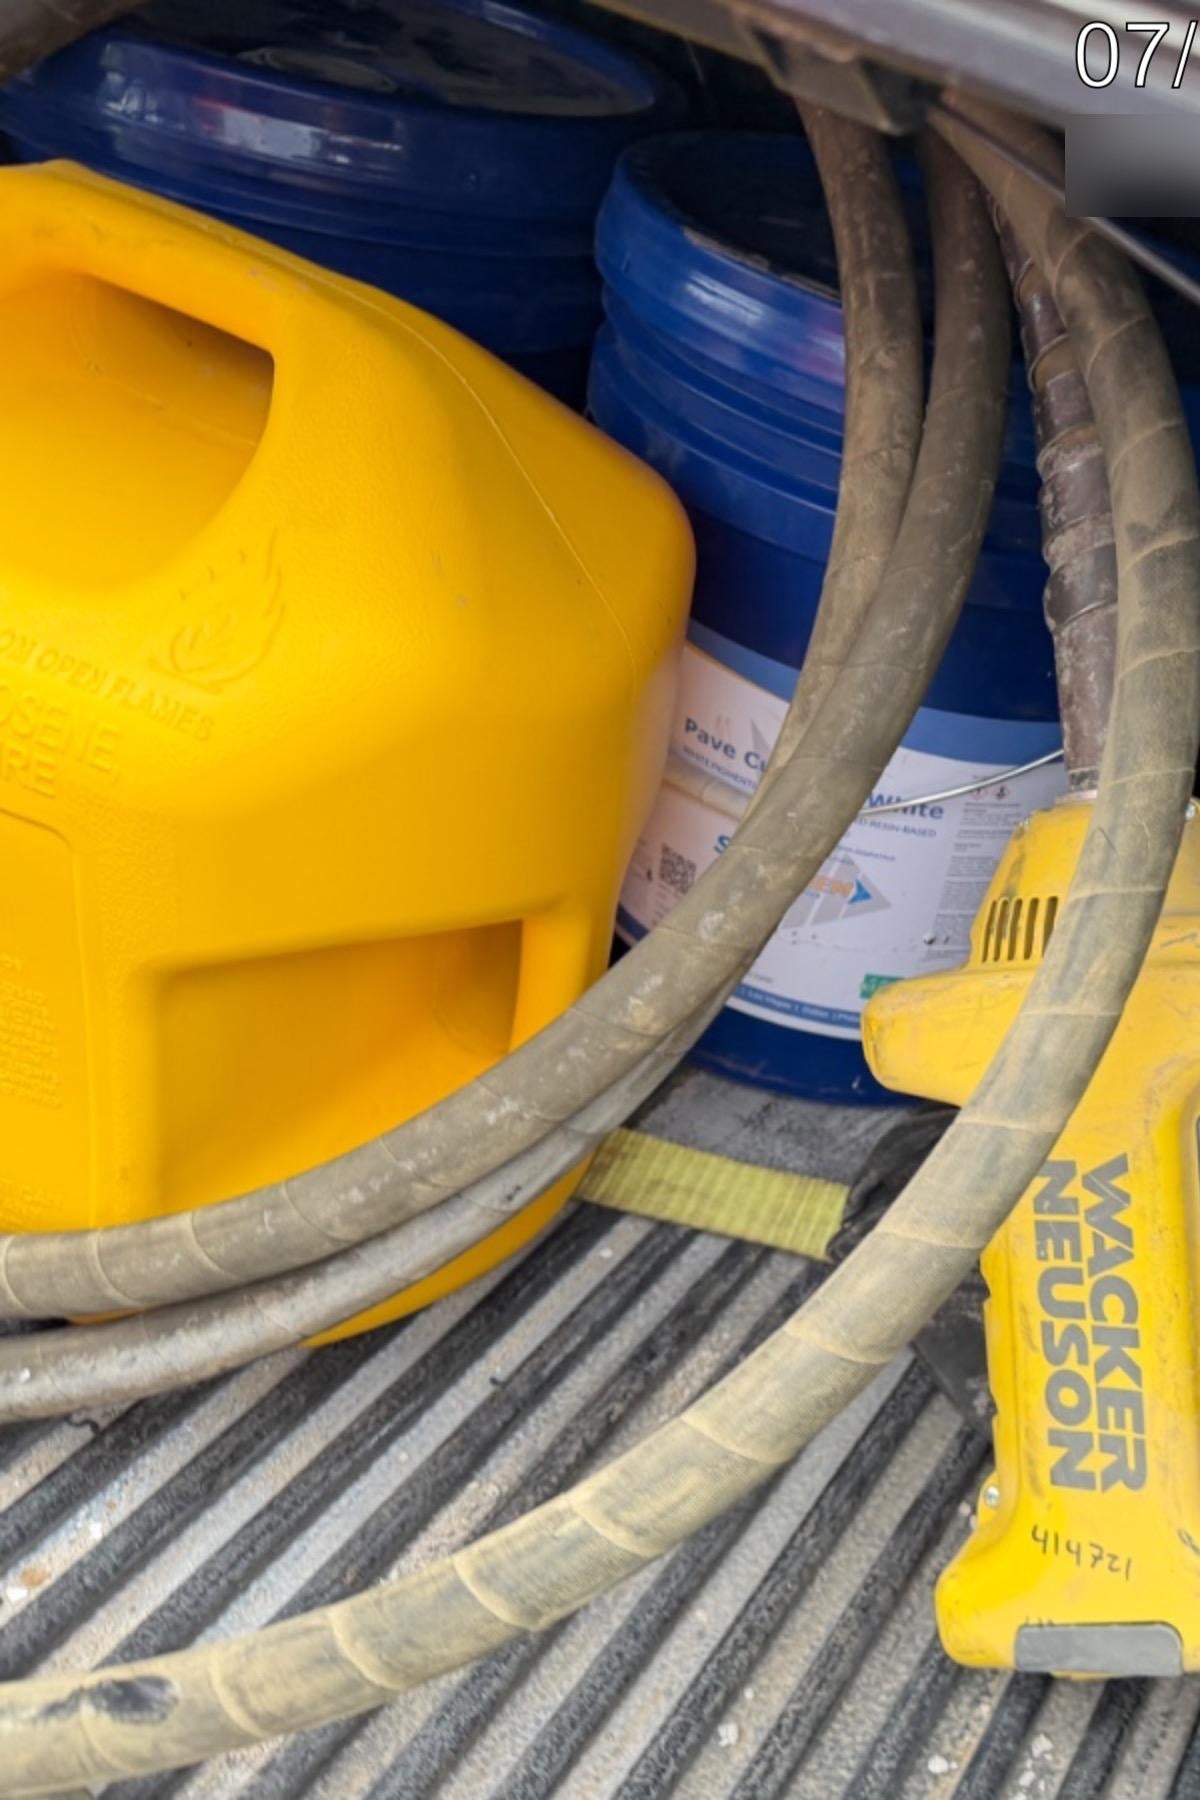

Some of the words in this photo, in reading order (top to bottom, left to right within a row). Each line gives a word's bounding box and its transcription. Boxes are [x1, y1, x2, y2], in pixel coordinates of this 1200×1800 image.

[36, 648, 109, 695] OPEN
[106, 675, 216, 742] FLAMES
[684, 715, 737, 761] Pave
[1033, 1158, 1097, 1493] NEUSON
[1081, 1152, 1147, 1494] WACKER
[1031, 1524, 1133, 1582] 414721
